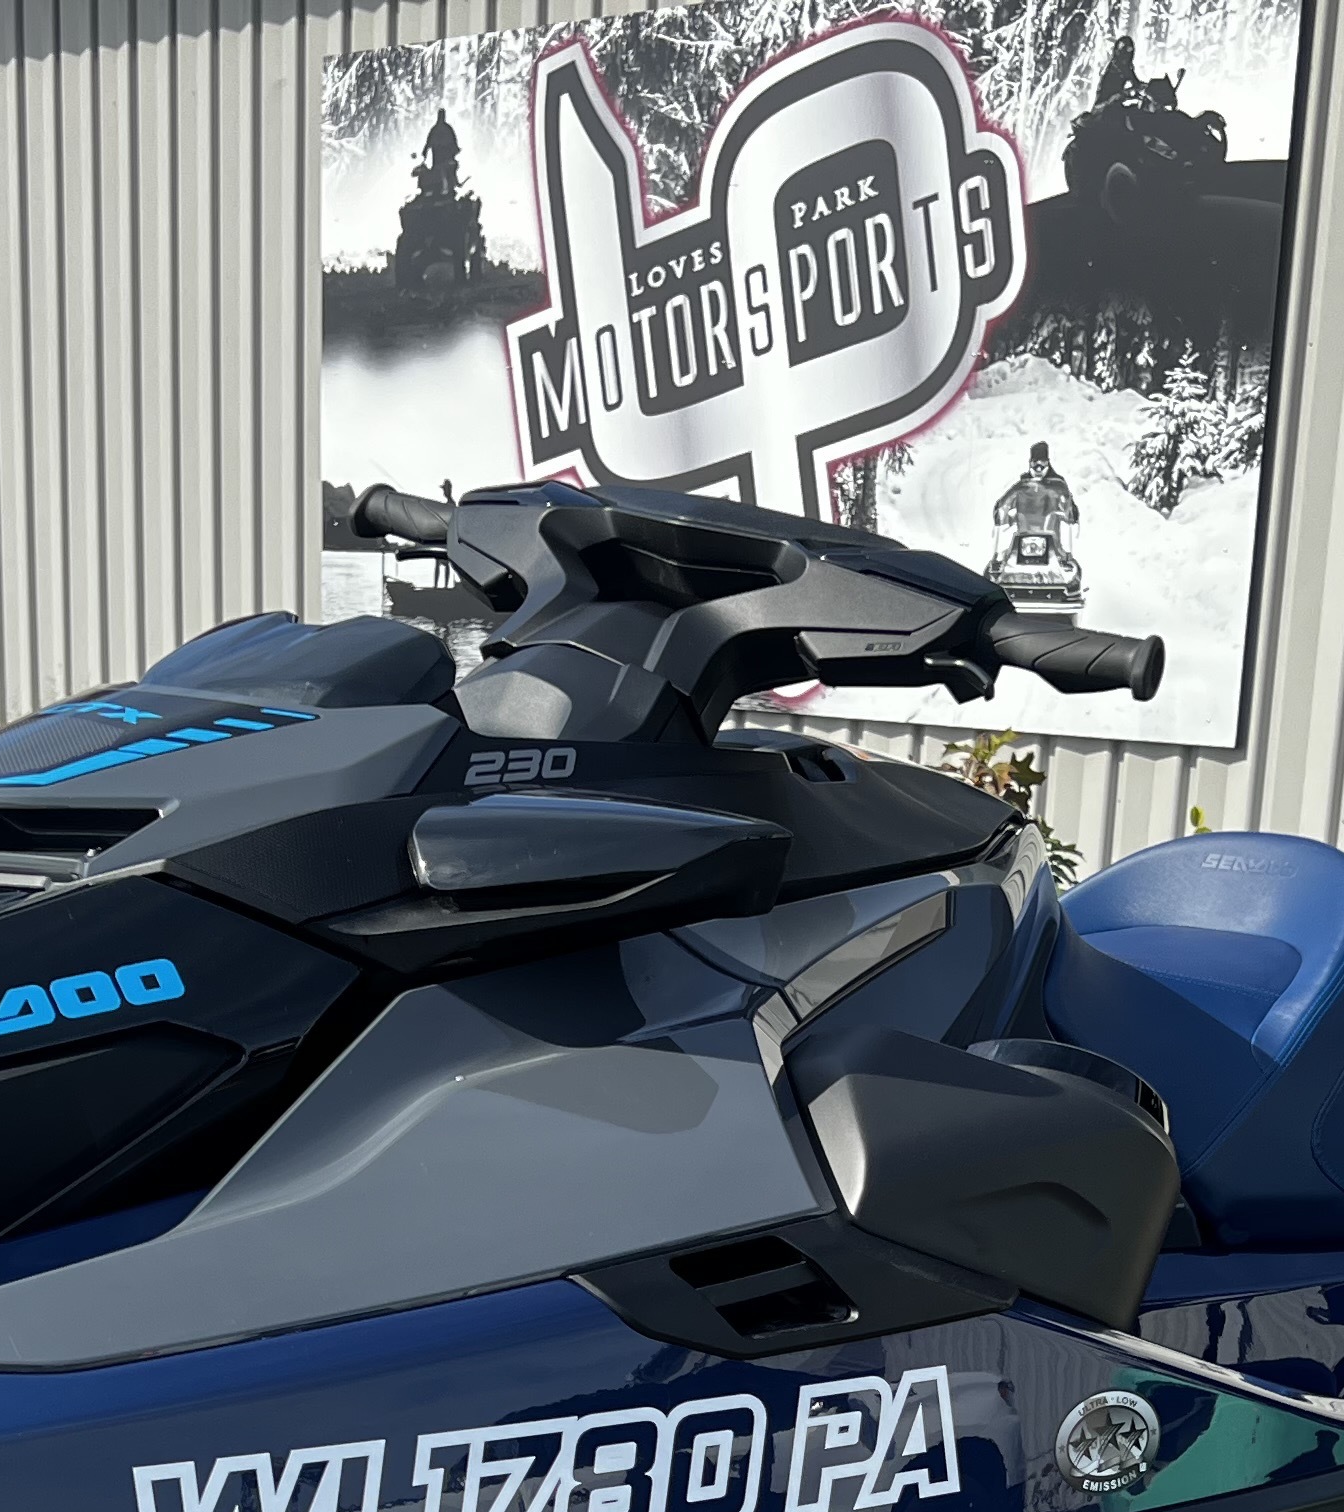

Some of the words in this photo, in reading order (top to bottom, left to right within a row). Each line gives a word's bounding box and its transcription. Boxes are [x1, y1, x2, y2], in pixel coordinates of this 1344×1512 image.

[791, 175, 880, 229] PARK
[630, 241, 725, 298] LOVES
[530, 174, 996, 440] MOTORSPORTS
[463, 747, 577, 786] 230
[1077, 1396, 1109, 1417] ULTRA
[1116, 1396, 1138, 1408] LOW
[1082, 1470, 1138, 1492] EMISSION
